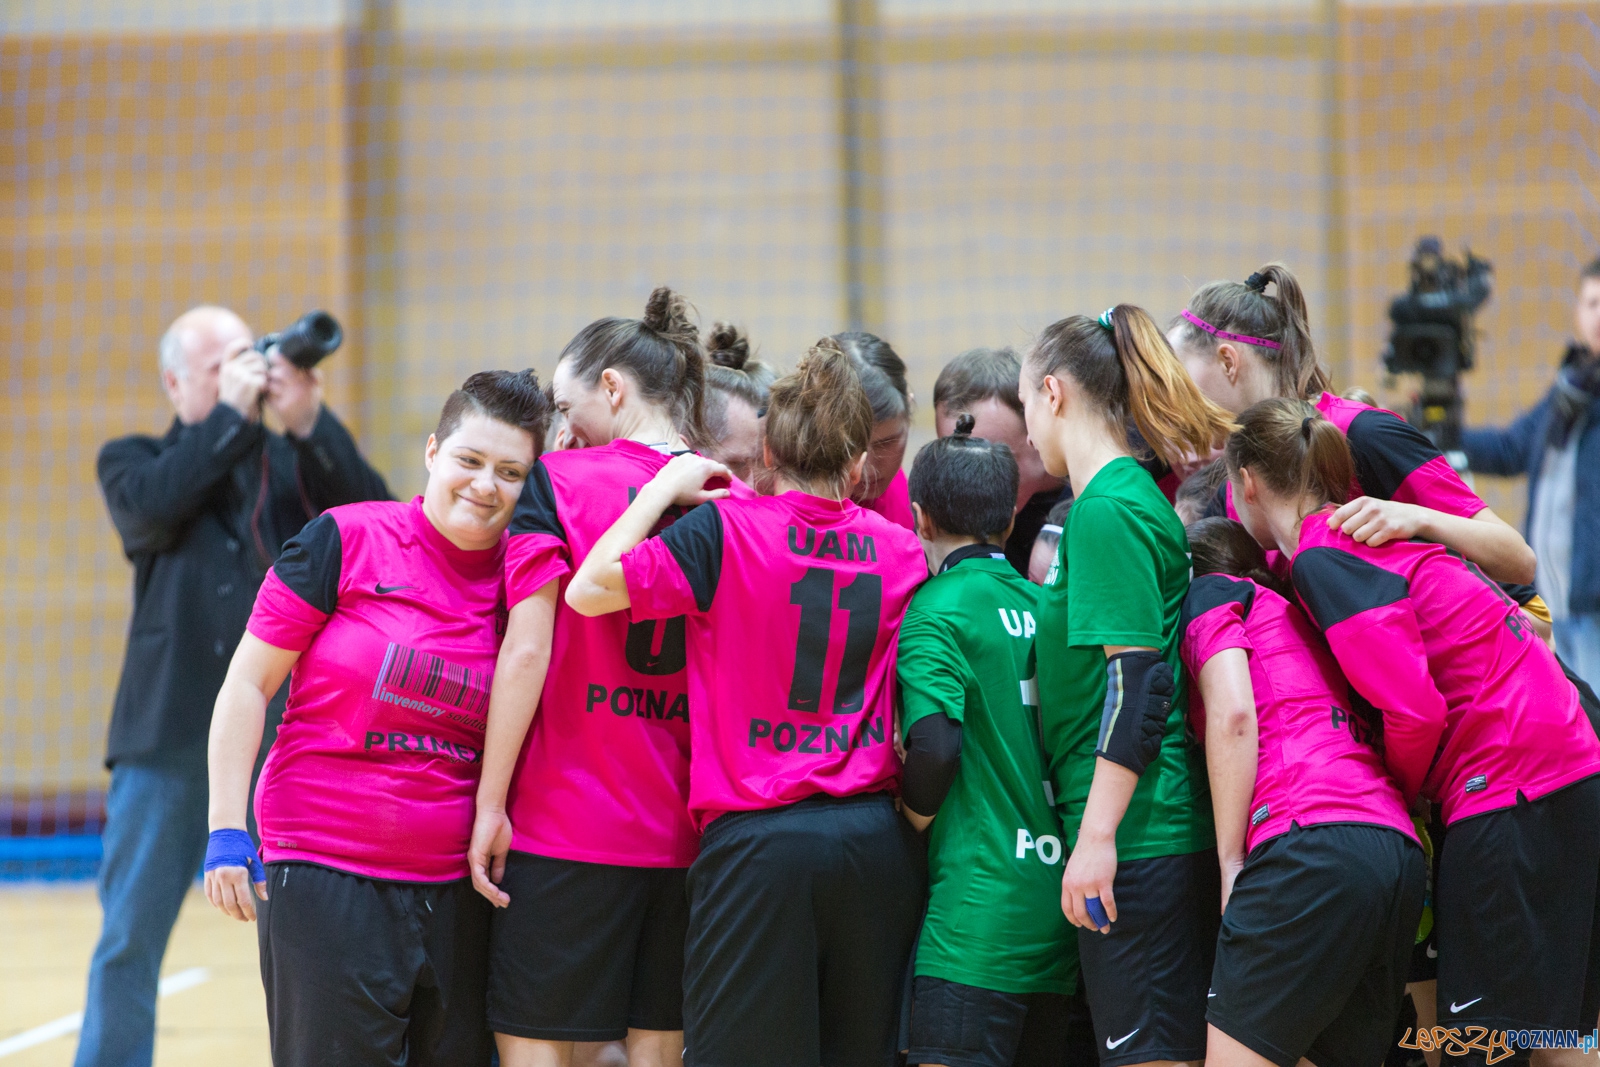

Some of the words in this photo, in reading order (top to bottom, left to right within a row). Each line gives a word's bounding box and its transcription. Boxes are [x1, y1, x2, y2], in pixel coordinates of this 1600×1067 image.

[787, 525, 878, 563] UAM
[787, 566, 882, 715] 11
[380, 687, 446, 718] inventory
